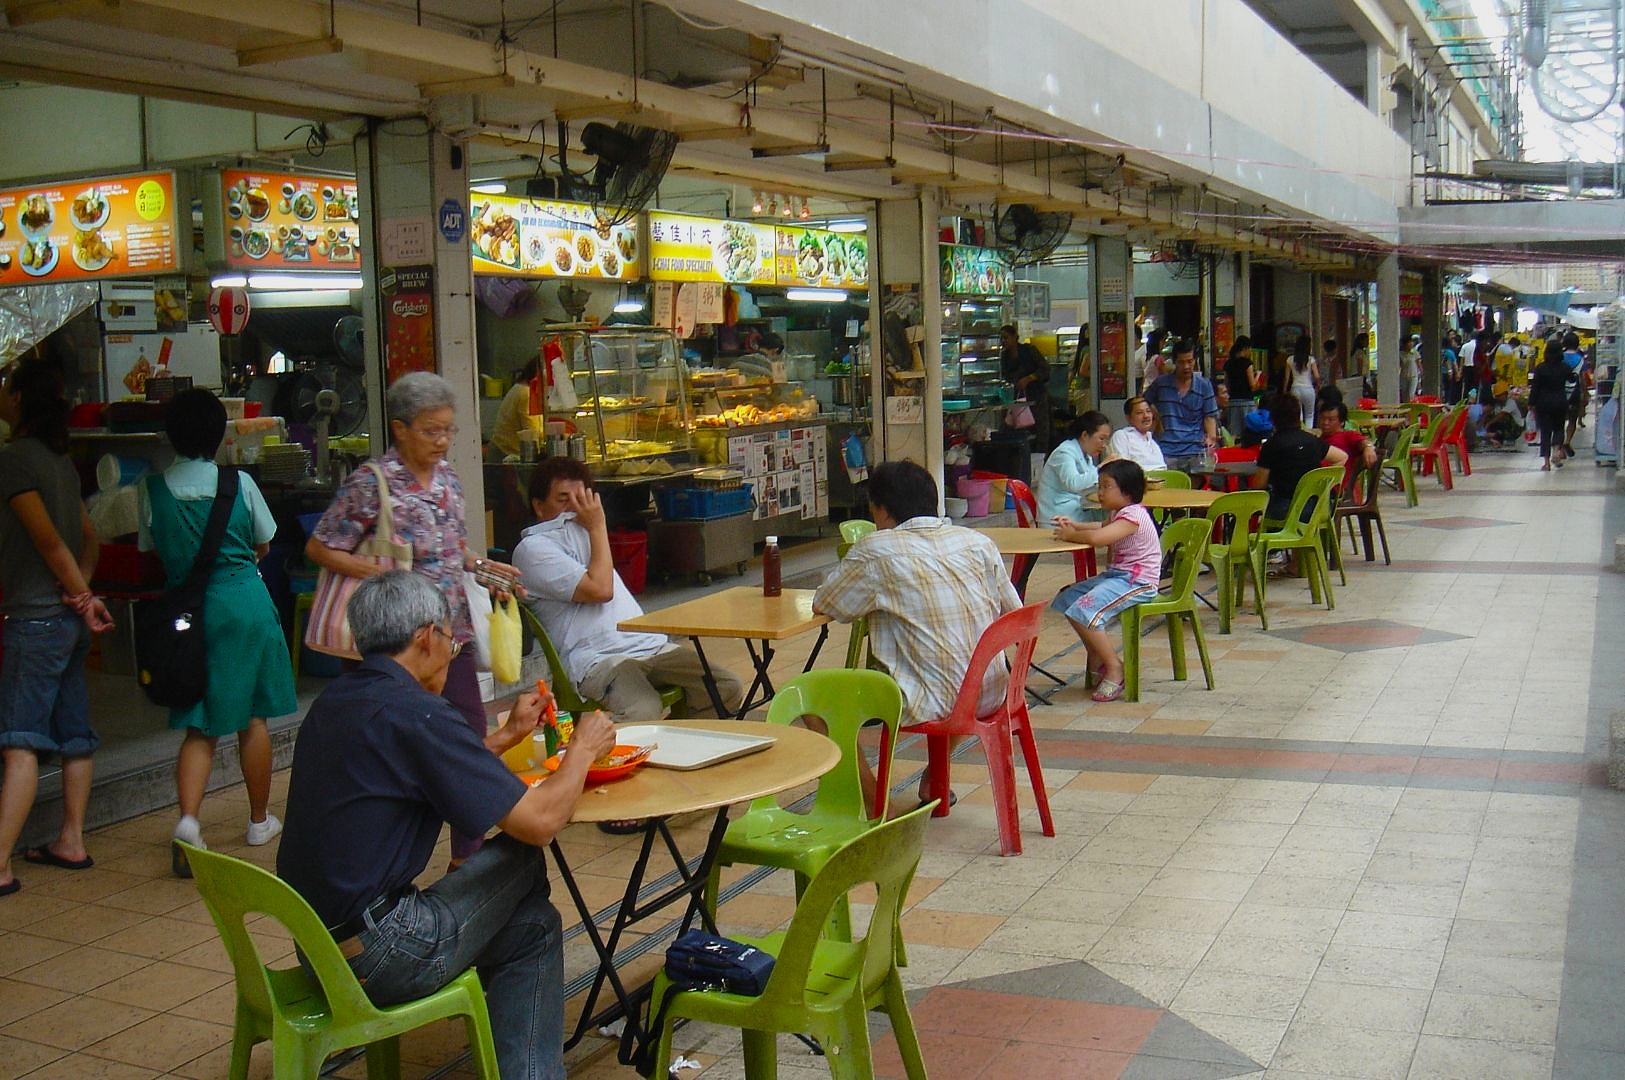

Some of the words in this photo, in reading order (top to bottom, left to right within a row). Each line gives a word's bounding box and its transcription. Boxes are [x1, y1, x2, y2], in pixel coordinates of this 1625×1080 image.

[443, 213, 462, 229] ADT
[397, 272, 430, 280] SPECIAL
[393, 300, 428, 317] Carlsberg
